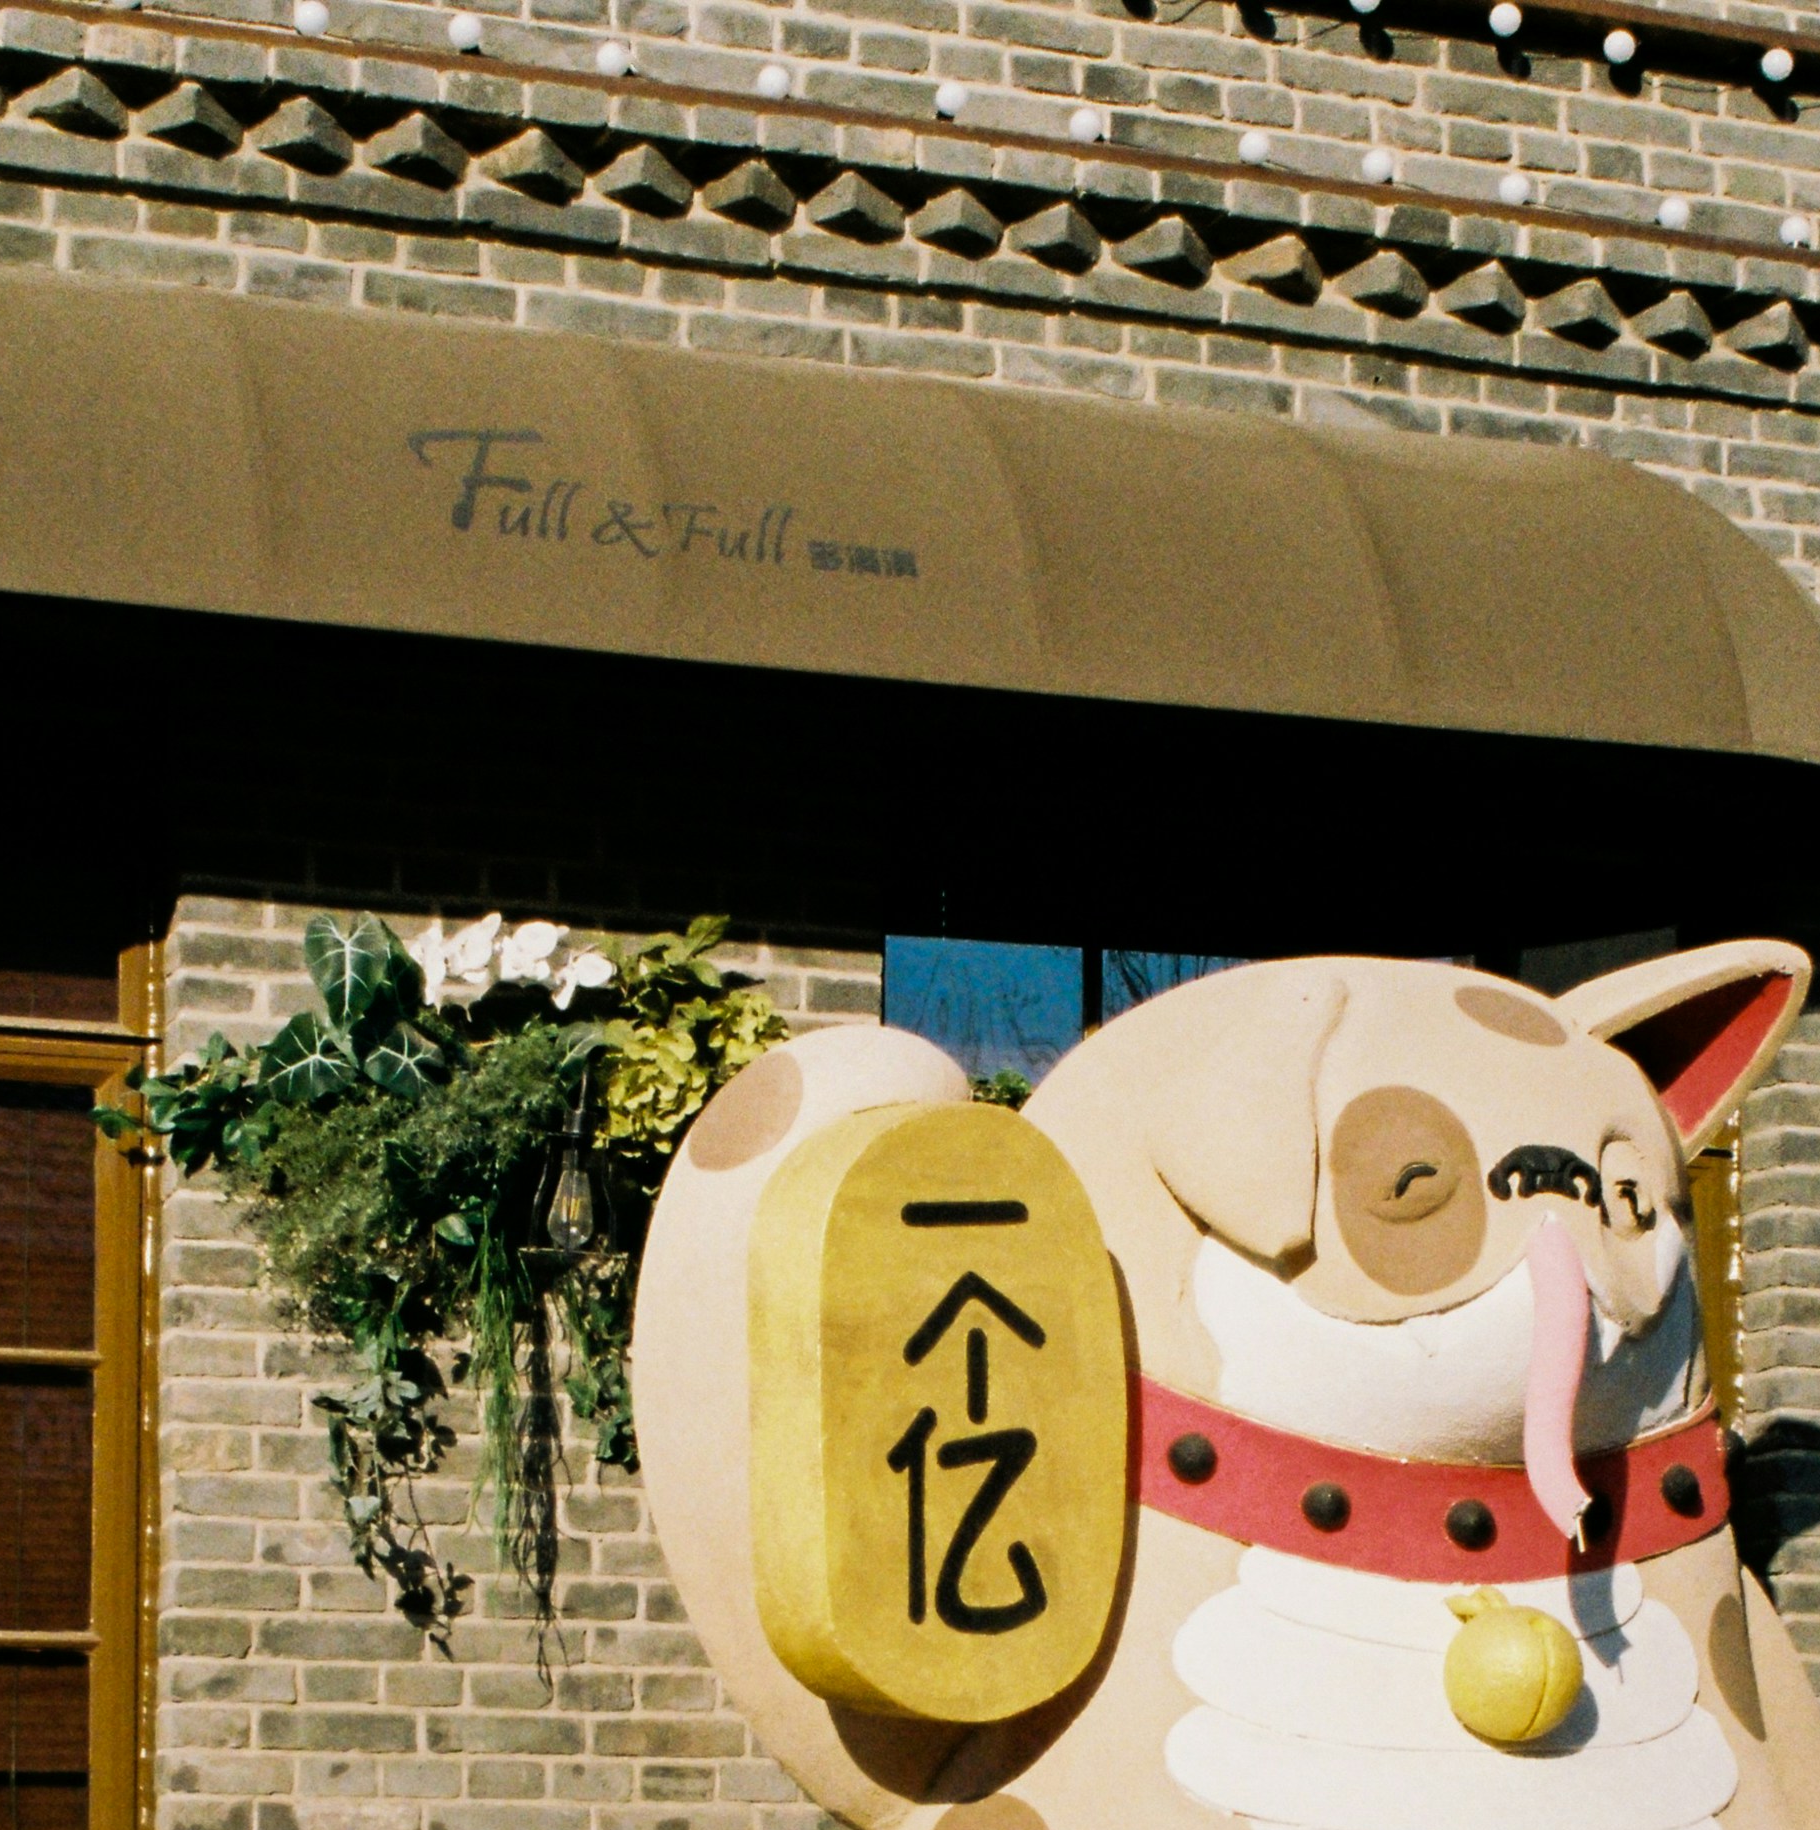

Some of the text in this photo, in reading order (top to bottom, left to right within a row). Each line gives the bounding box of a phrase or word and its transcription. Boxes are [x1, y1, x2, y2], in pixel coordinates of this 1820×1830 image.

[407, 429, 580, 541] Full
[592, 500, 660, 559] &
[663, 503, 794, 564] Full
[886, 1200, 1048, 1635] 一个亿
